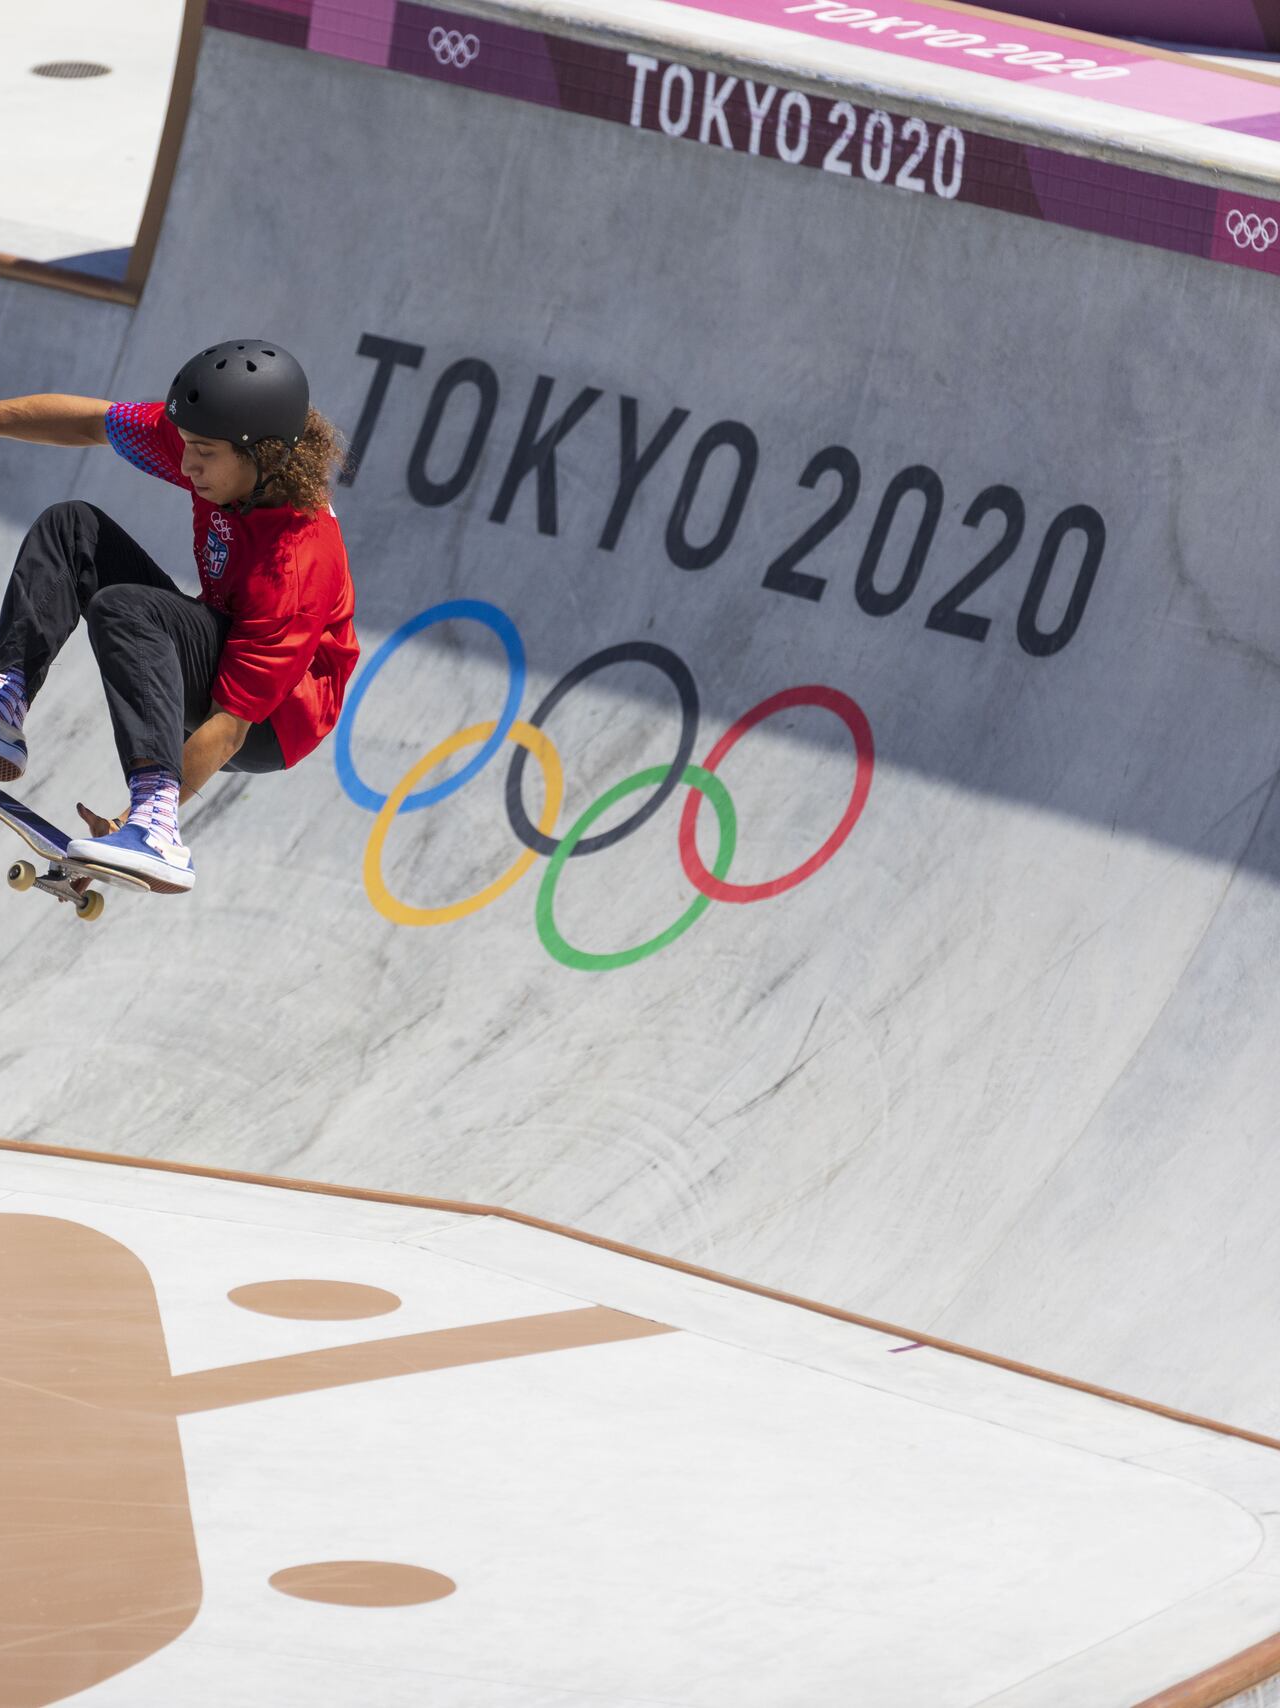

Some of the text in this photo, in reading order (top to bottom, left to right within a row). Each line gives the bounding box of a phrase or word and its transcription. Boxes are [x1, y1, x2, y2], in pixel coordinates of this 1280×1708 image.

[784, 0, 1130, 80] TOKYO 2020
[627, 53, 964, 199] TOKYO 2020
[337, 333, 1107, 657] TOKYO 2020
